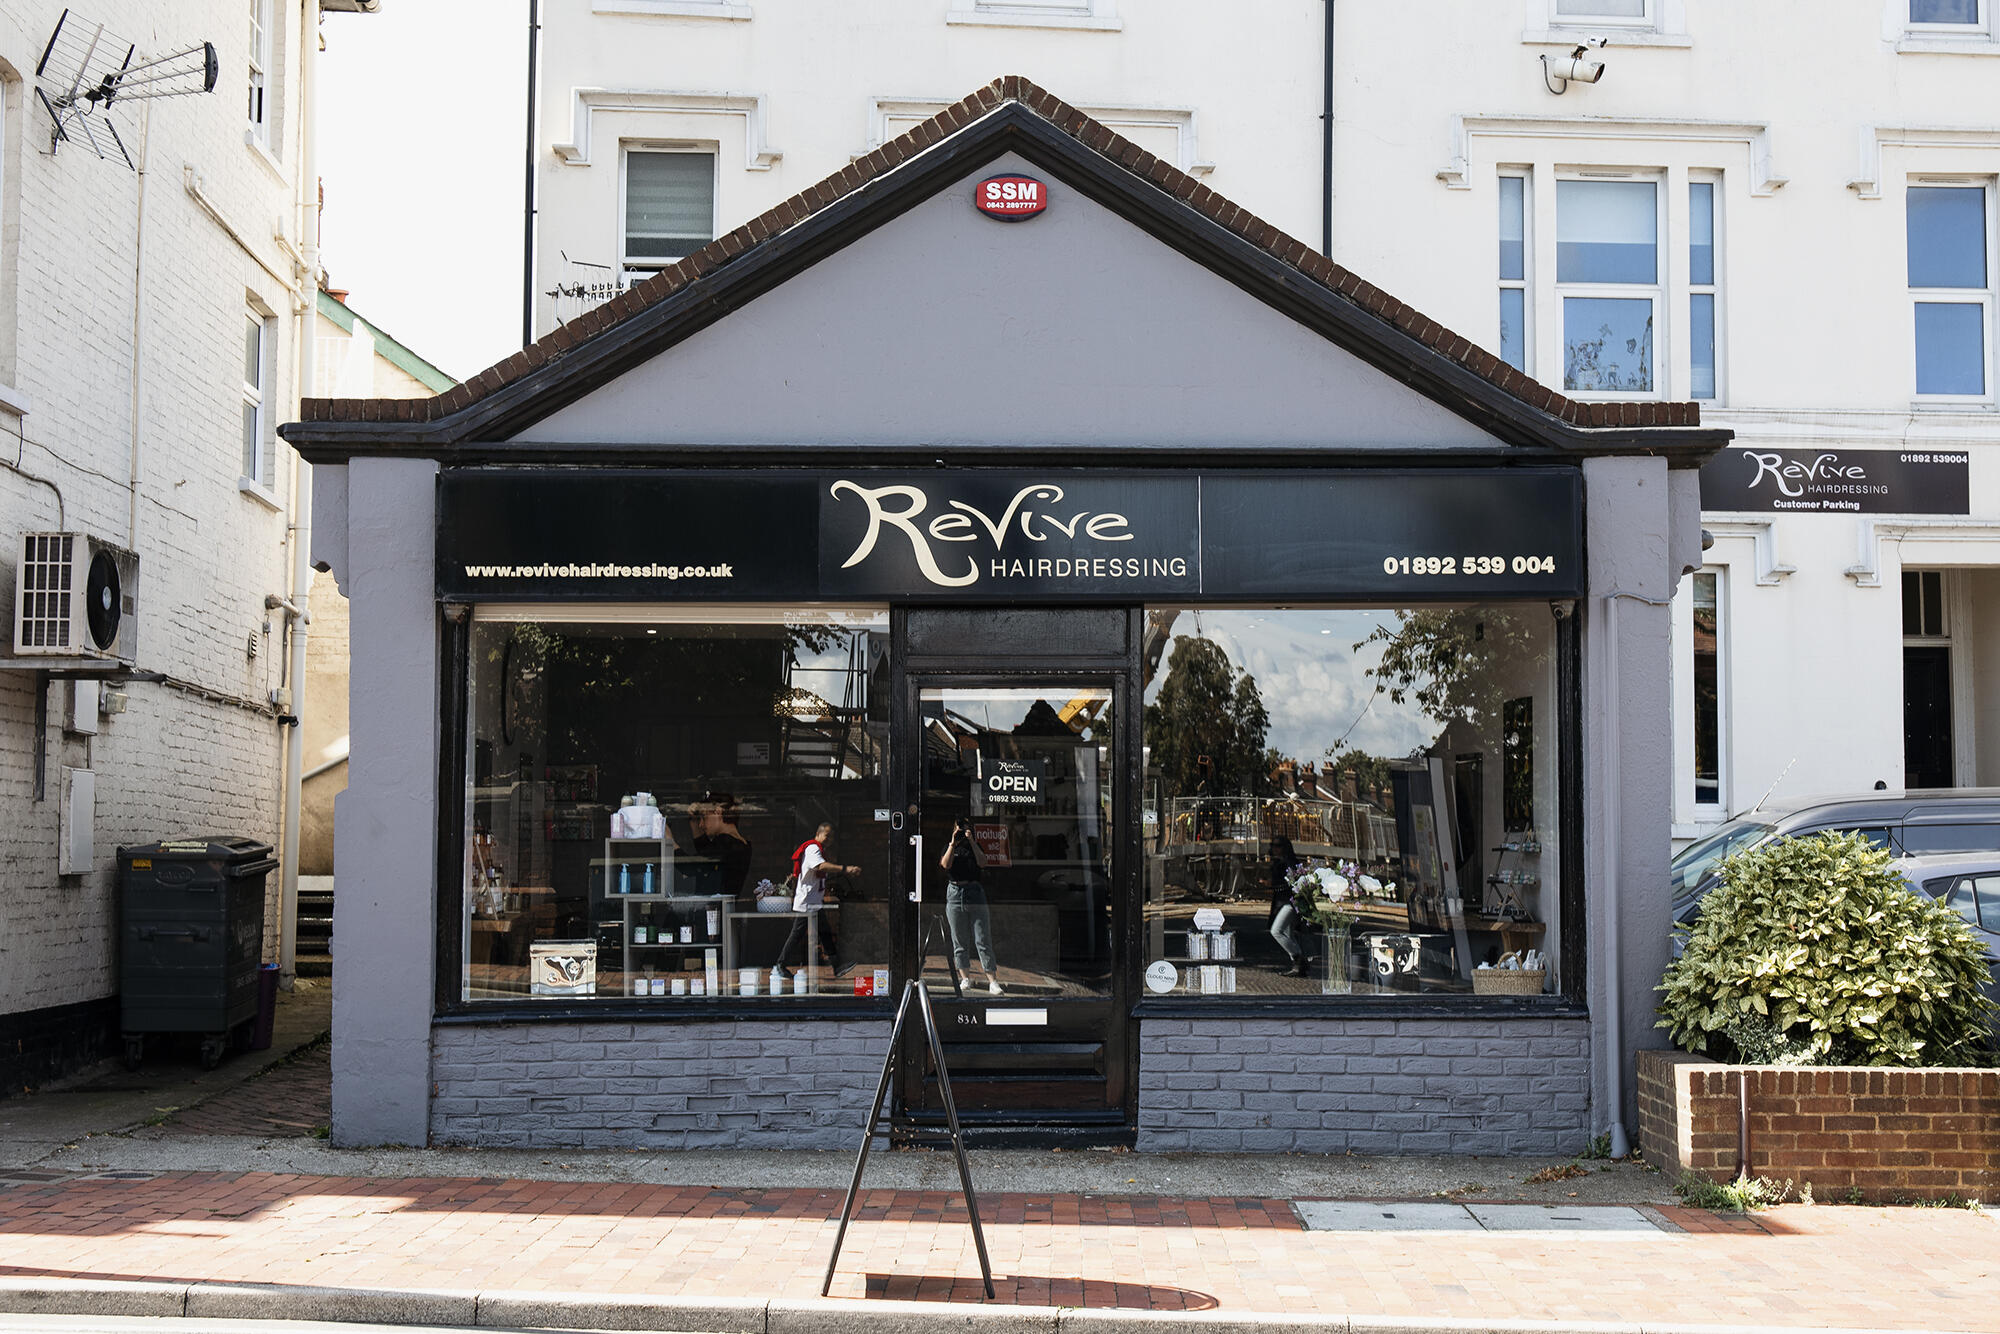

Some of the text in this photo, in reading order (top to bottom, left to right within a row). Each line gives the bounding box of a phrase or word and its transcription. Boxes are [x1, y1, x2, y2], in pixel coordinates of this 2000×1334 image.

[986, 182, 1037, 200] SSM
[1900, 454, 1968, 464] 01892 539004
[1807, 484, 1889, 495] HAIRDRESSING
[1773, 500, 1860, 511] Customer Parking
[464, 562, 733, 580] www.revivehairdressing.co.uk
[991, 557, 1187, 578] HAIRDRESSING
[1383, 555, 1556, 575] 01892 539 004
[988, 775, 1038, 792] OPEN
[988, 795, 1036, 803] 01892 539004
[957, 1013, 978, 1025] 83A
